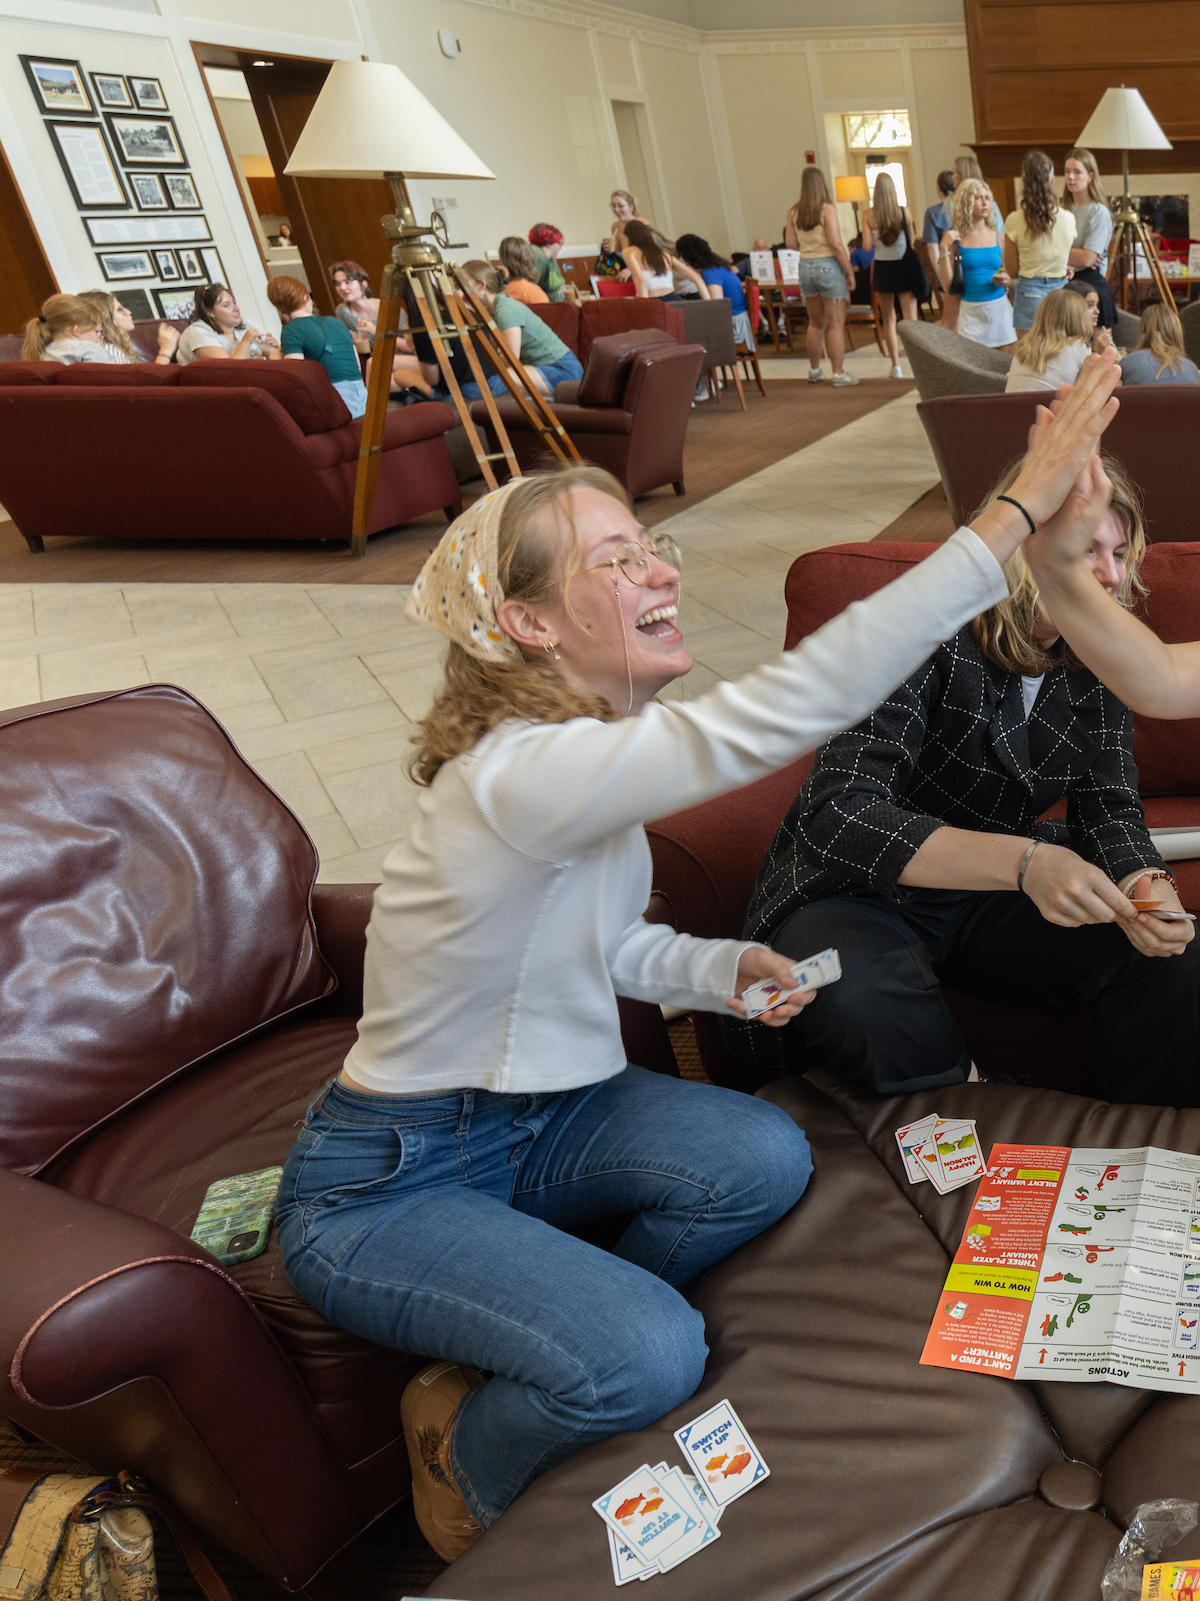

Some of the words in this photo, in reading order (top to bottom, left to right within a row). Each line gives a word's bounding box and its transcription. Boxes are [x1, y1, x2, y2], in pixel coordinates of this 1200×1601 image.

[944, 1154, 977, 1167] SALMON
[948, 1161, 975, 1171] HAPPY
[1007, 1259, 1036, 1267] THREE
[1009, 1284, 1030, 1292] HOW
[959, 1356, 981, 1365] FIND
[964, 1348, 1013, 1361] PARTNER?
[983, 1359, 1011, 1370] CAN'T
[1089, 1367, 1129, 1377] ACTIONS
[691, 1420, 733, 1451] SWITCH
[702, 1443, 713, 1454] IT
[715, 1432, 729, 1446] UP
[657, 1512, 670, 1522] IT
[638, 1512, 681, 1547] SWITCH
[641, 1521, 657, 1535] UP
[1148, 1566, 1162, 1598] GAMES.
